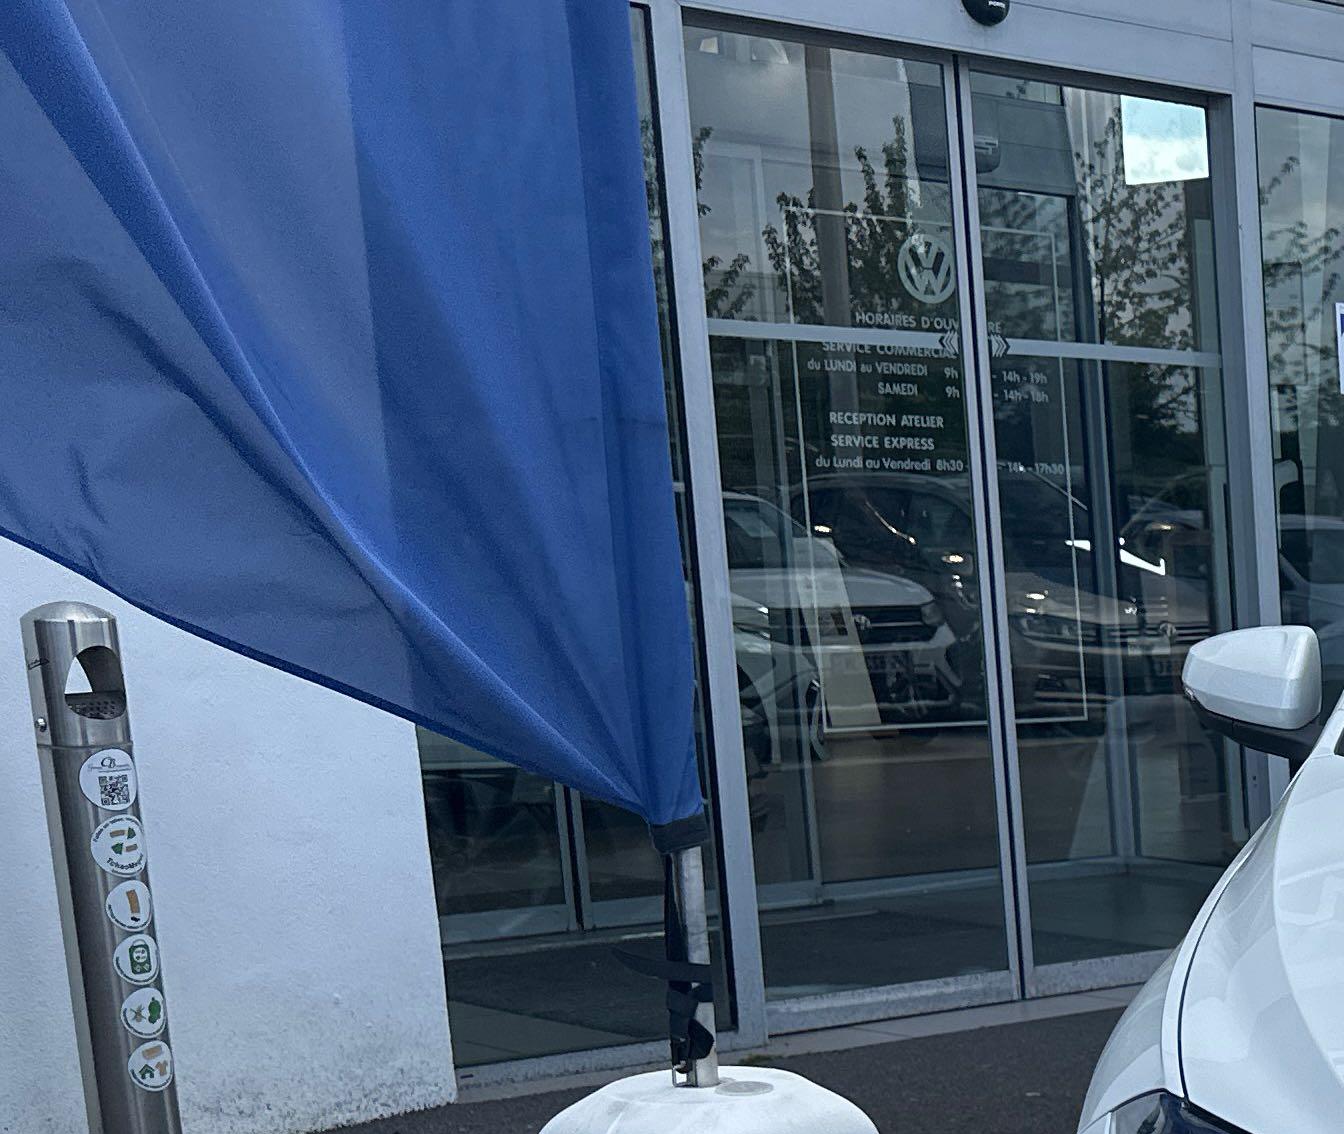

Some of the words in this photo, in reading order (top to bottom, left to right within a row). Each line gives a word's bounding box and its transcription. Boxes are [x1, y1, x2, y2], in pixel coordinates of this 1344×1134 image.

[855, 311, 917, 328] HORAIRES
[807, 358, 821, 371] du
[824, 359, 857, 372] LUNDI
[860, 362, 873, 373] au
[875, 361, 928, 377] VENDREDI
[943, 366, 959, 379] 9h
[877, 382, 919, 396] SAMEDI
[945, 386, 960, 399] 9h
[829, 411, 897, 427] RECEPTION
[900, 414, 945, 429] ATELIER
[830, 434, 880, 448] SERVICE
[884, 436, 935, 451] EXPRESS
[815, 454, 831, 468] du
[832, 455, 863, 468] Lundi
[865, 459, 881, 469] au
[881, 457, 932, 471] Vendredi
[936, 459, 964, 472] 8h30
